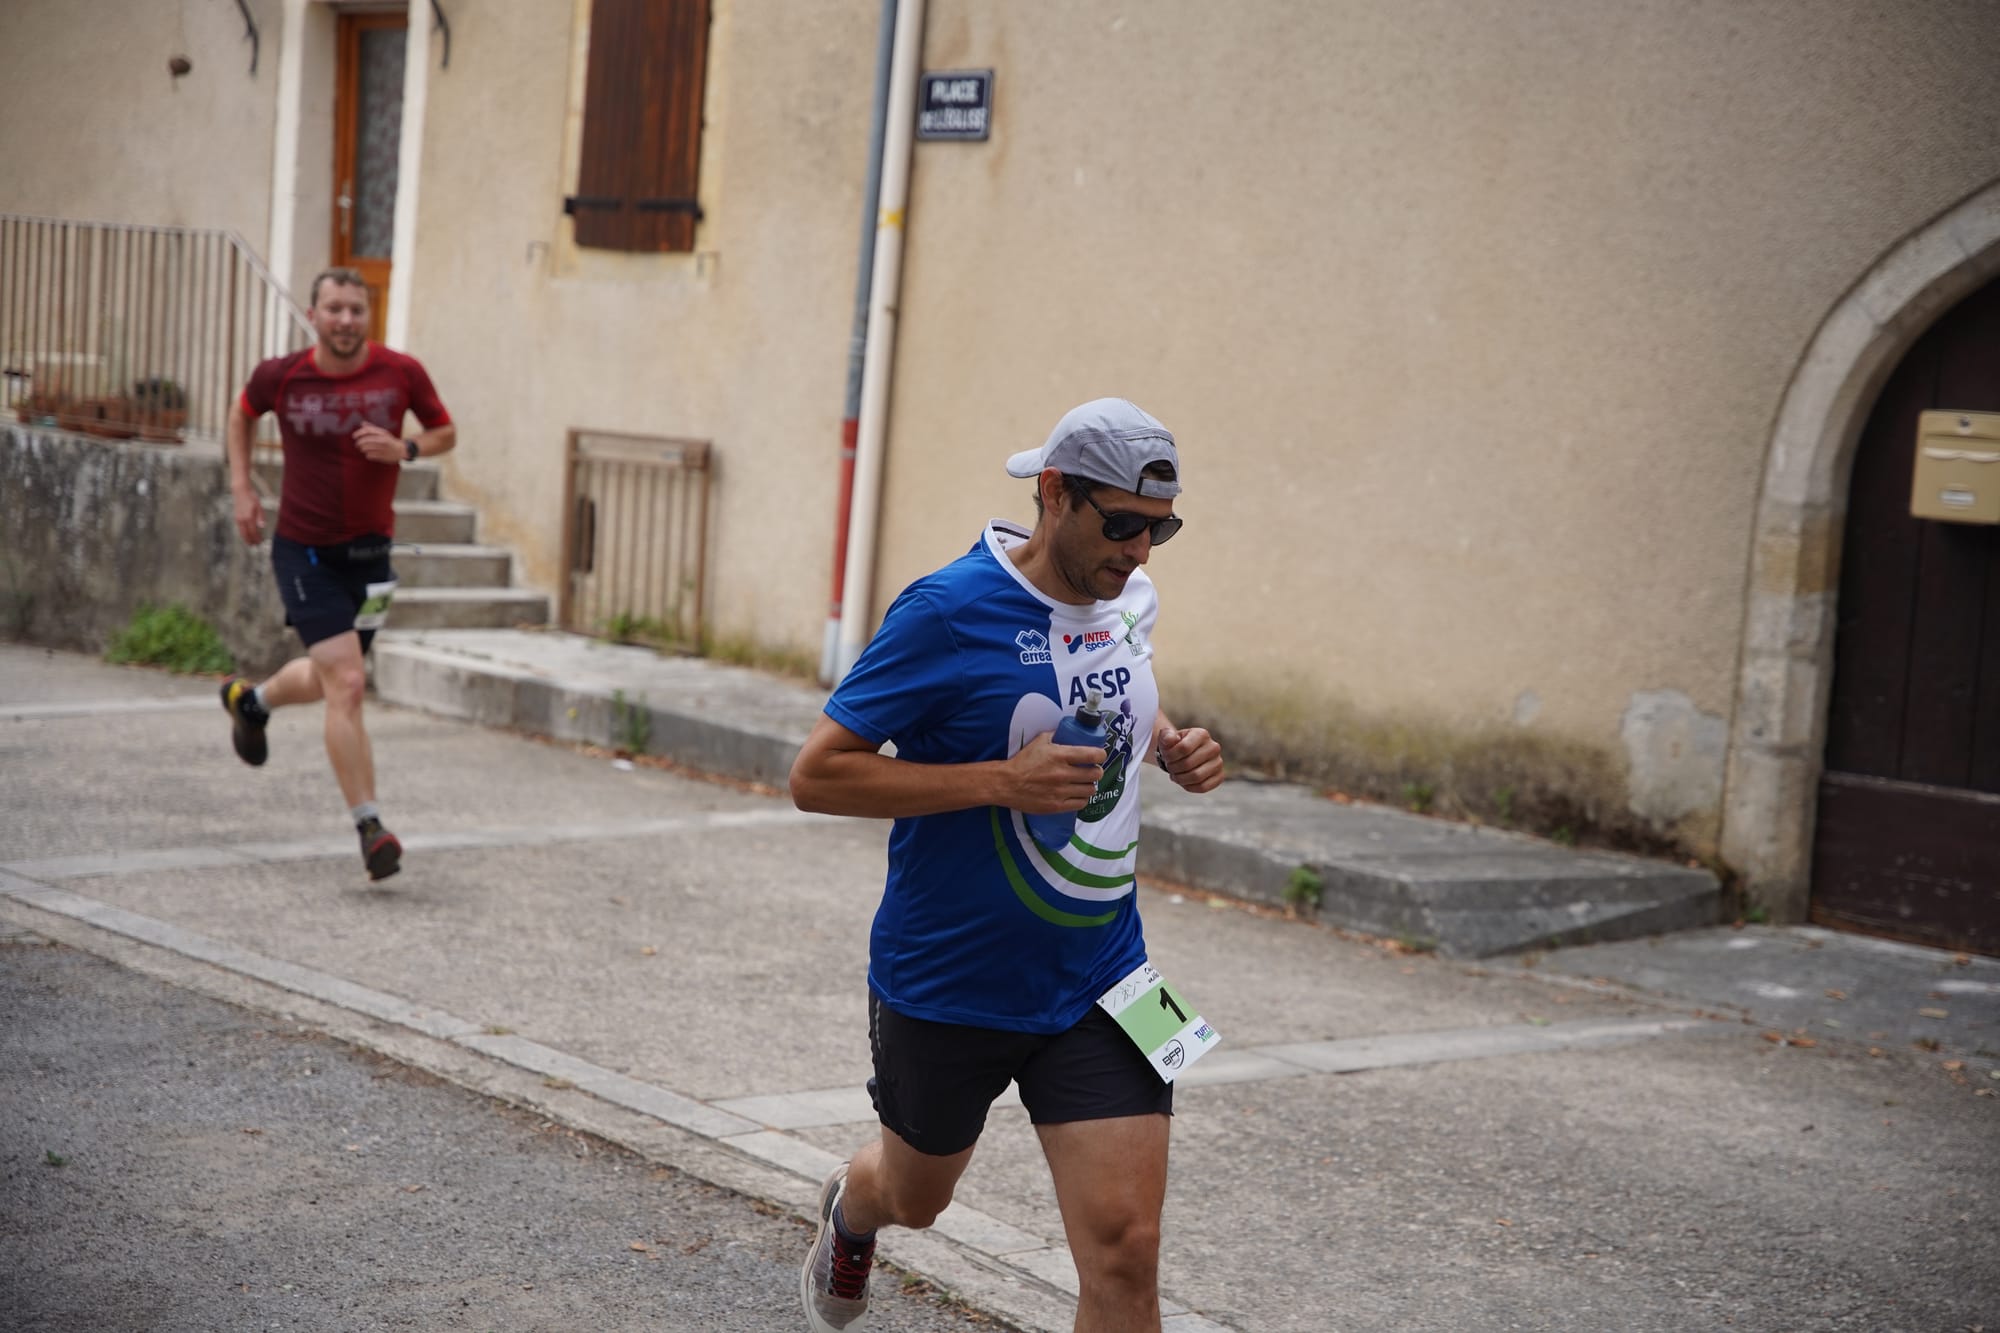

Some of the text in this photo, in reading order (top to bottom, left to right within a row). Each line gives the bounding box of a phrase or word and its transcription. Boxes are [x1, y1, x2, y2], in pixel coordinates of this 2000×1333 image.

[931, 80, 979, 103] PLACE
[1084, 630, 1111, 642] INTER
[1085, 638, 1117, 652] SPORT
[1069, 666, 1131, 706] ASSP
[1160, 986, 1188, 1024] 1
[1162, 1047, 1181, 1067] BFP
